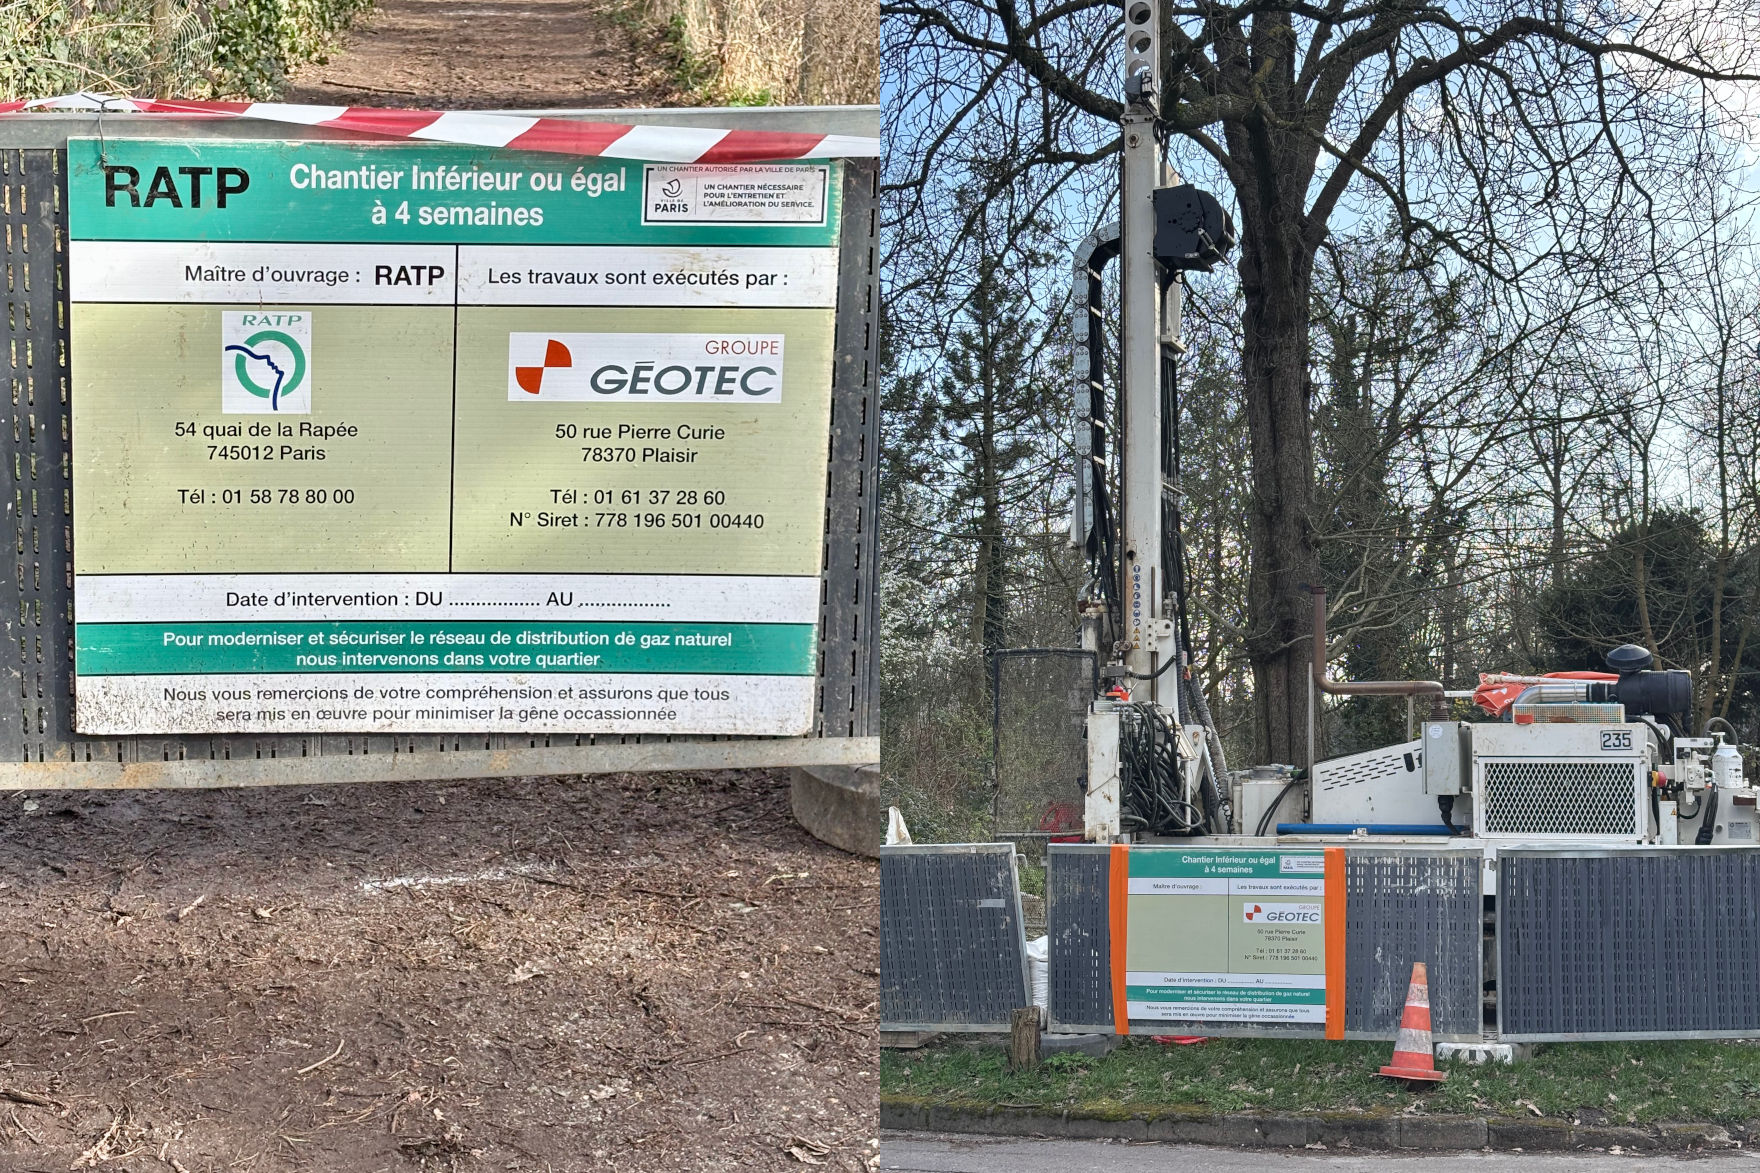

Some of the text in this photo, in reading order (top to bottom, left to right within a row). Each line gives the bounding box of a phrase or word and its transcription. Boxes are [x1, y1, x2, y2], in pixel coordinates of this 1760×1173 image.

[104, 165, 250, 209] RATP
[290, 163, 625, 197] Chantier Inférieur ou égal
[757, 183, 803, 191] NÉCESSAIRE
[371, 199, 543, 226] à 4 semaines
[654, 203, 688, 212] PARIS
[185, 265, 444, 286] Maître d'ouvrage RATP
[488, 268, 777, 289] Les travaux sont exécutés par
[242, 314, 301, 325] RATP
[705, 340, 778, 355] GROUPE
[590, 360, 776, 395] GÉOTEC
[175, 421, 357, 440] 54 quai de la Rapée
[555, 424, 724, 439] 50 rue Pierre Curie
[207, 445, 325, 460] 745012 Paris
[581, 447, 698, 462] 78370 Plaisir
[177, 489, 354, 503] Tél 01 58 78 80 00
[550, 489, 724, 505] Tél 01 61 37 28 60
[510, 512, 763, 528] N° Siret 778 196 501 00440
[226, 591, 572, 606] Date d'intervention DU AU
[163, 630, 731, 648] Pour moderniser et sécuriser le réseau de distribution de gaz naturel
[296, 651, 600, 668] nous intervenons dans votre quartier
[164, 686, 207, 701] Nous
[211, 690, 251, 701] vous
[353, 686, 373, 699] de
[379, 686, 420, 698] votre
[425, 684, 552, 701] compréhension
[558, 685, 573, 700] et
[578, 686, 652, 699] assurons
[657, 688, 689, 703] que
[693, 686, 730, 701] tous
[217, 706, 676, 724] sera mis en œuvre pour minimiser la gêne occassionnée
[1602, 733, 1631, 748] 235
[1182, 856, 1213, 864] Chantier
[1215, 856, 1246, 864] Inférieur
[1259, 856, 1275, 866] égal
[1204, 865, 1209, 873] à
[1217, 866, 1253, 874] semaines
[1172, 883, 1199, 891] d'ouvrage
[1266, 911, 1319, 922] GÉOTEC
